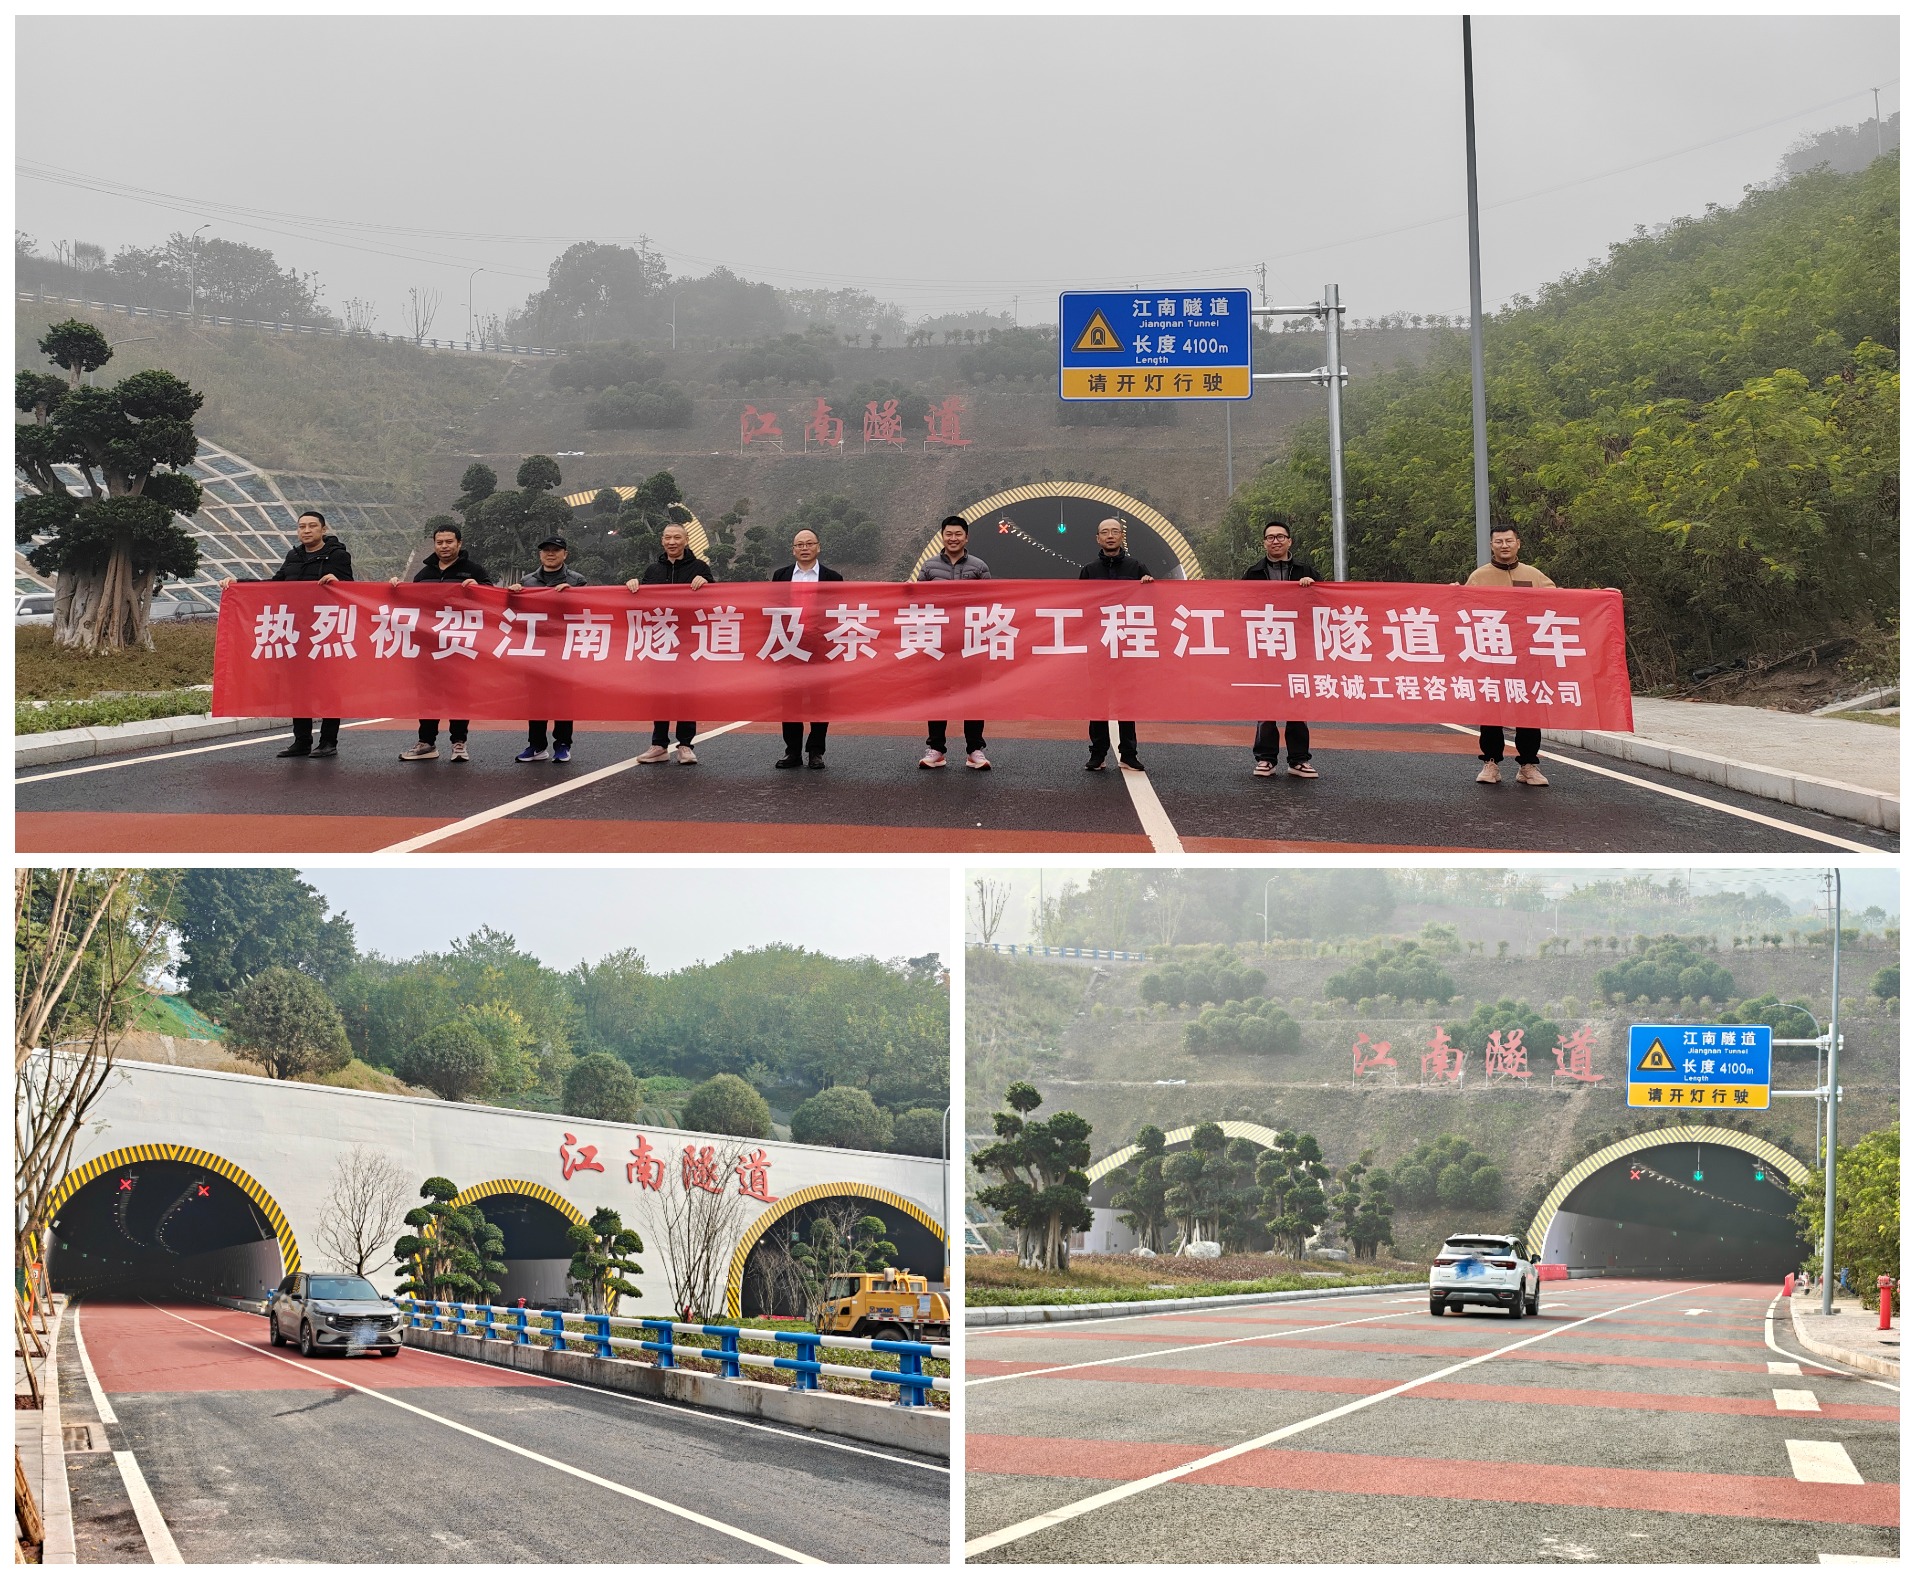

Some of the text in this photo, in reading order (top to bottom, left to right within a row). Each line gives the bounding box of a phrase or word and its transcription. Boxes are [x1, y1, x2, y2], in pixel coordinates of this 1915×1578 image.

[1132, 297, 1230, 318] 江南隧道
[1139, 319, 1220, 330] Jiangnan Tunnel
[1132, 334, 1229, 354] 长度 4100m
[1135, 355, 1169, 366] Length
[1088, 373, 1224, 393] 请开灯行驶
[740, 396, 973, 447] 江南隧道
[250, 602, 1588, 668] 热烈祝贺江南隧道及茶黄路工程江南隧道通车
[1683, 1031, 1757, 1046] 江南隧道
[1352, 1025, 1605, 1083] 江南隧道
[1687, 1047, 1749, 1056] Jiangnan Tunnel
[1682, 1059, 1754, 1075] 长度 4100m
[1684, 1074, 1709, 1083] Length
[1647, 1087, 1749, 1104] 请开灯行驶
[559, 1132, 780, 1203] 江南隧道
